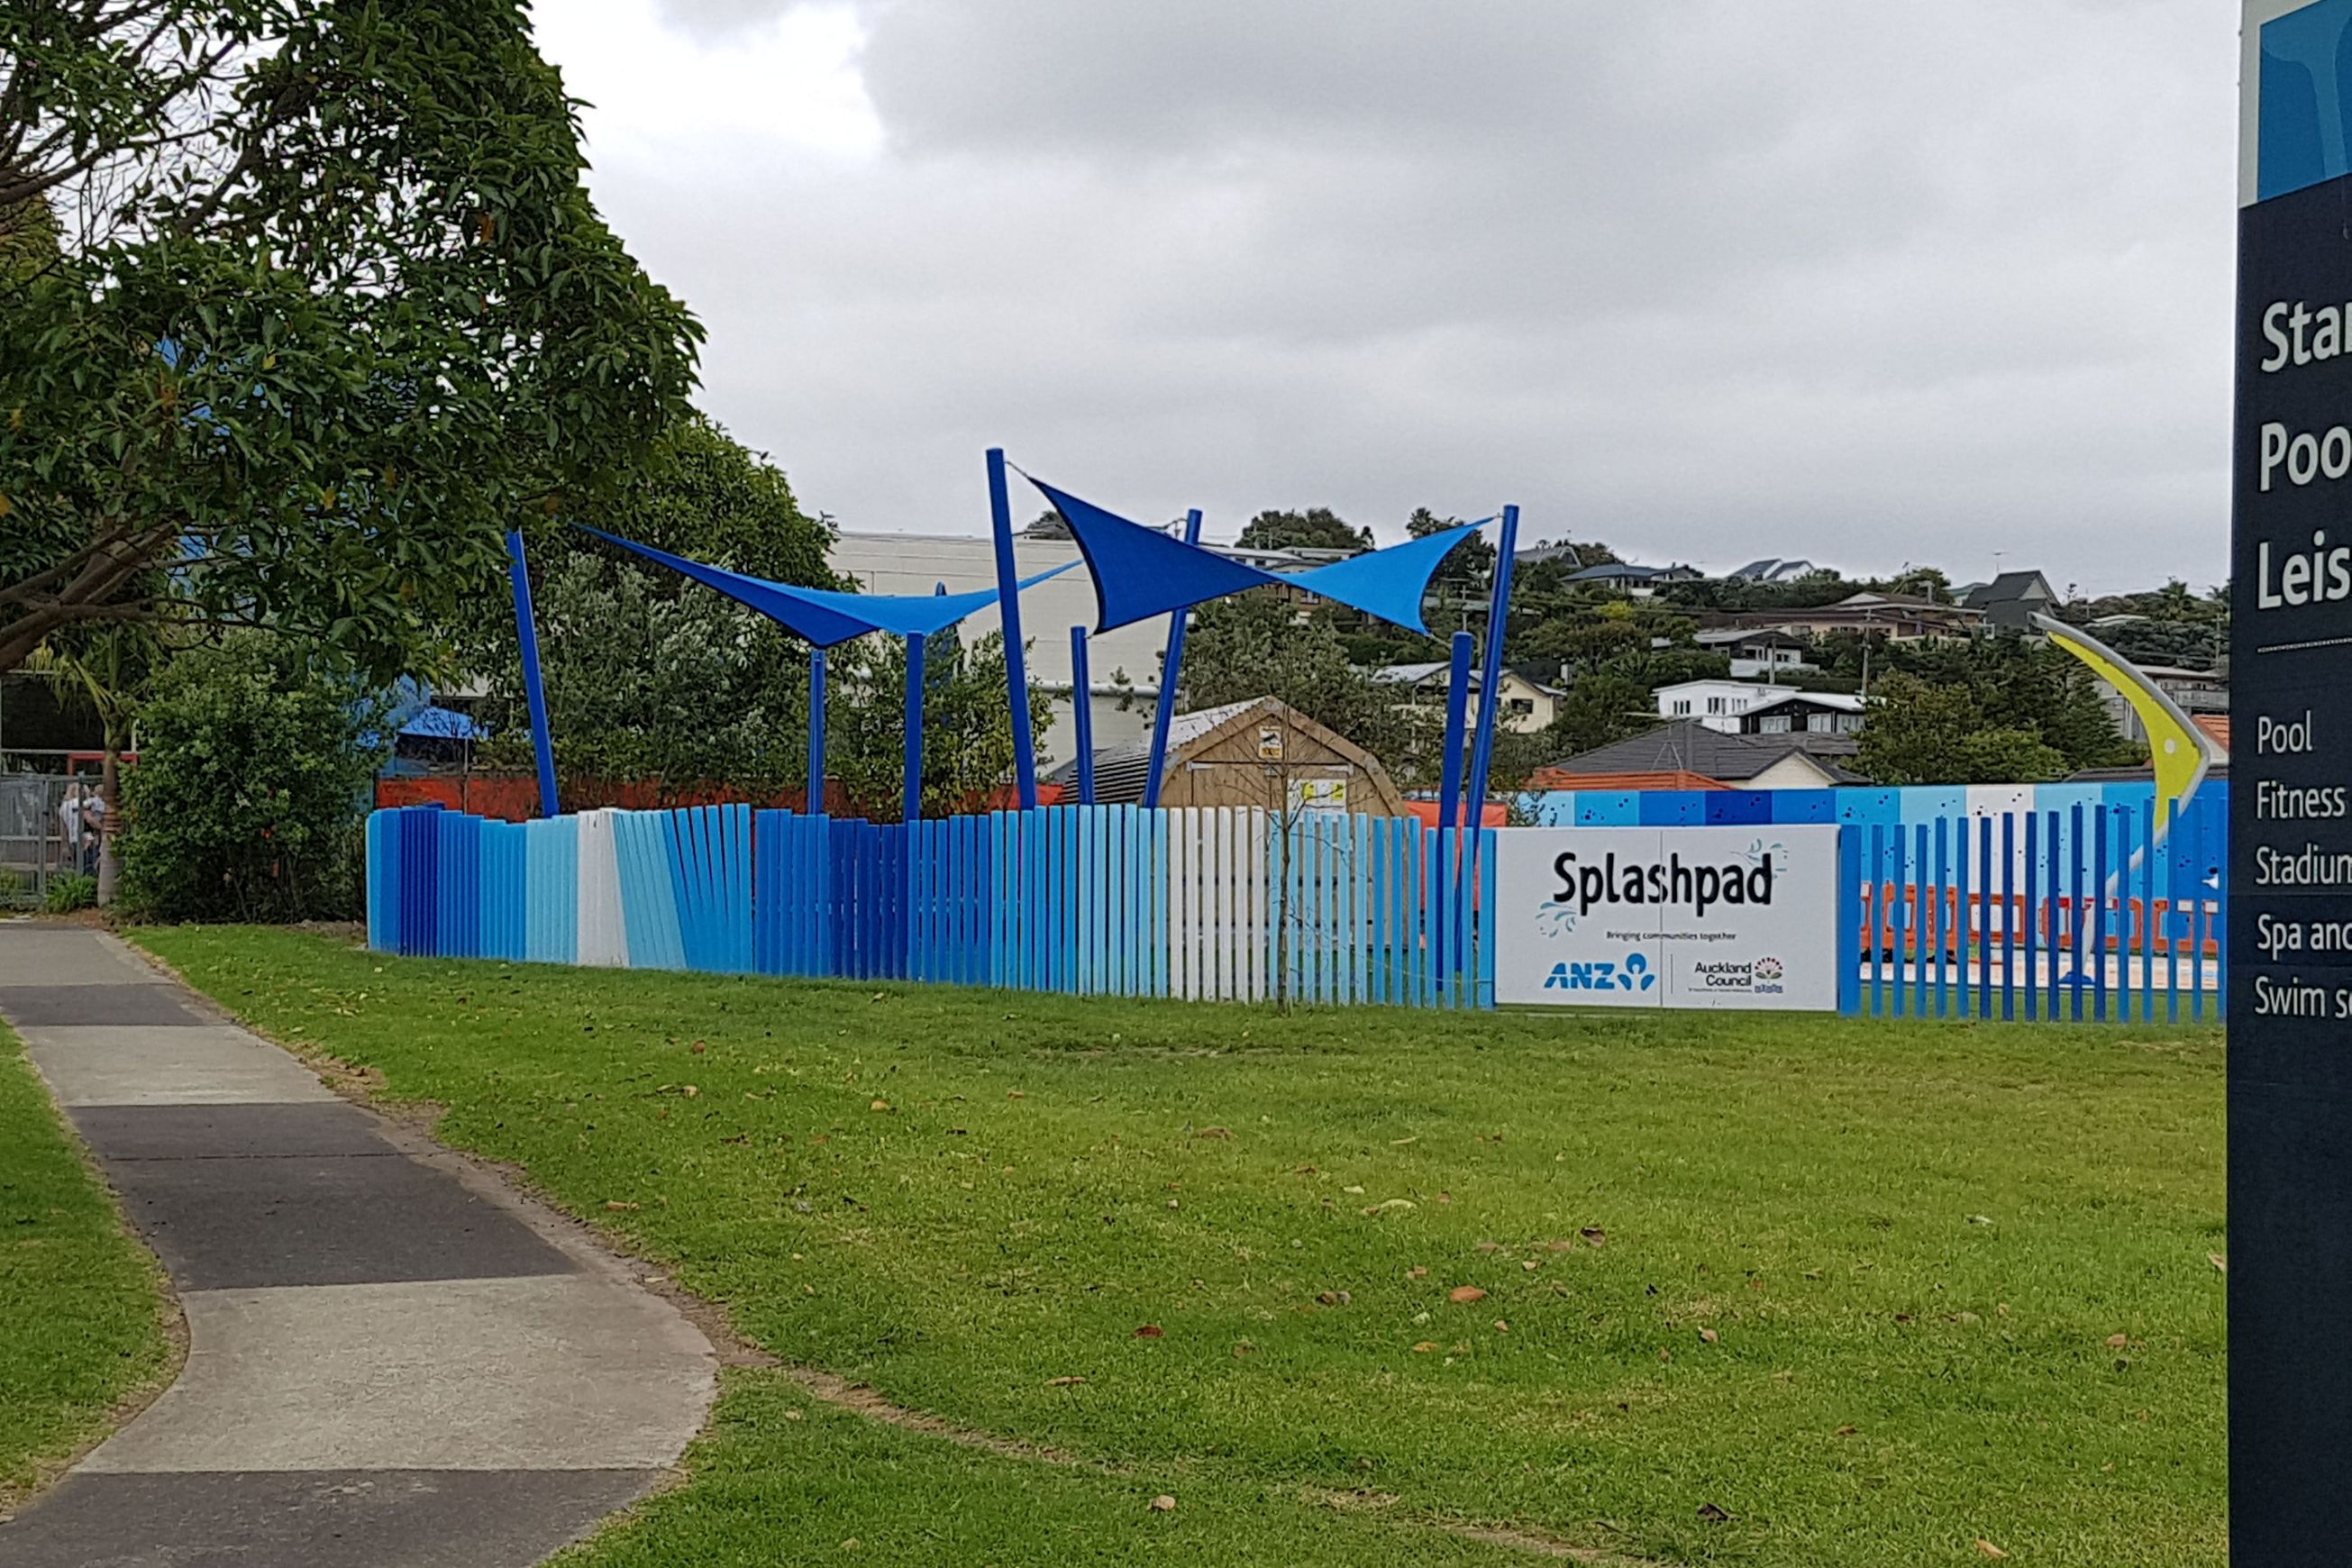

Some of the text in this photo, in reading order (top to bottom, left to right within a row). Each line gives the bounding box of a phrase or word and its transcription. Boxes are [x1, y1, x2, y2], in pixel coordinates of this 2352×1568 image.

[2257, 709, 2313, 755] Pool
[2256, 780, 2347, 819] Fitness
[1553, 852, 1773, 917] Splashpad
[1606, 931, 1641, 942] Bringing
[1700, 931, 1737, 942] together
[2256, 914, 2302, 961] Spa
[1544, 962, 1616, 989] ANZ
[1694, 962, 1752, 974] Auckland
[1705, 974, 1752, 987] Council
[2255, 976, 2326, 1017] Swim
